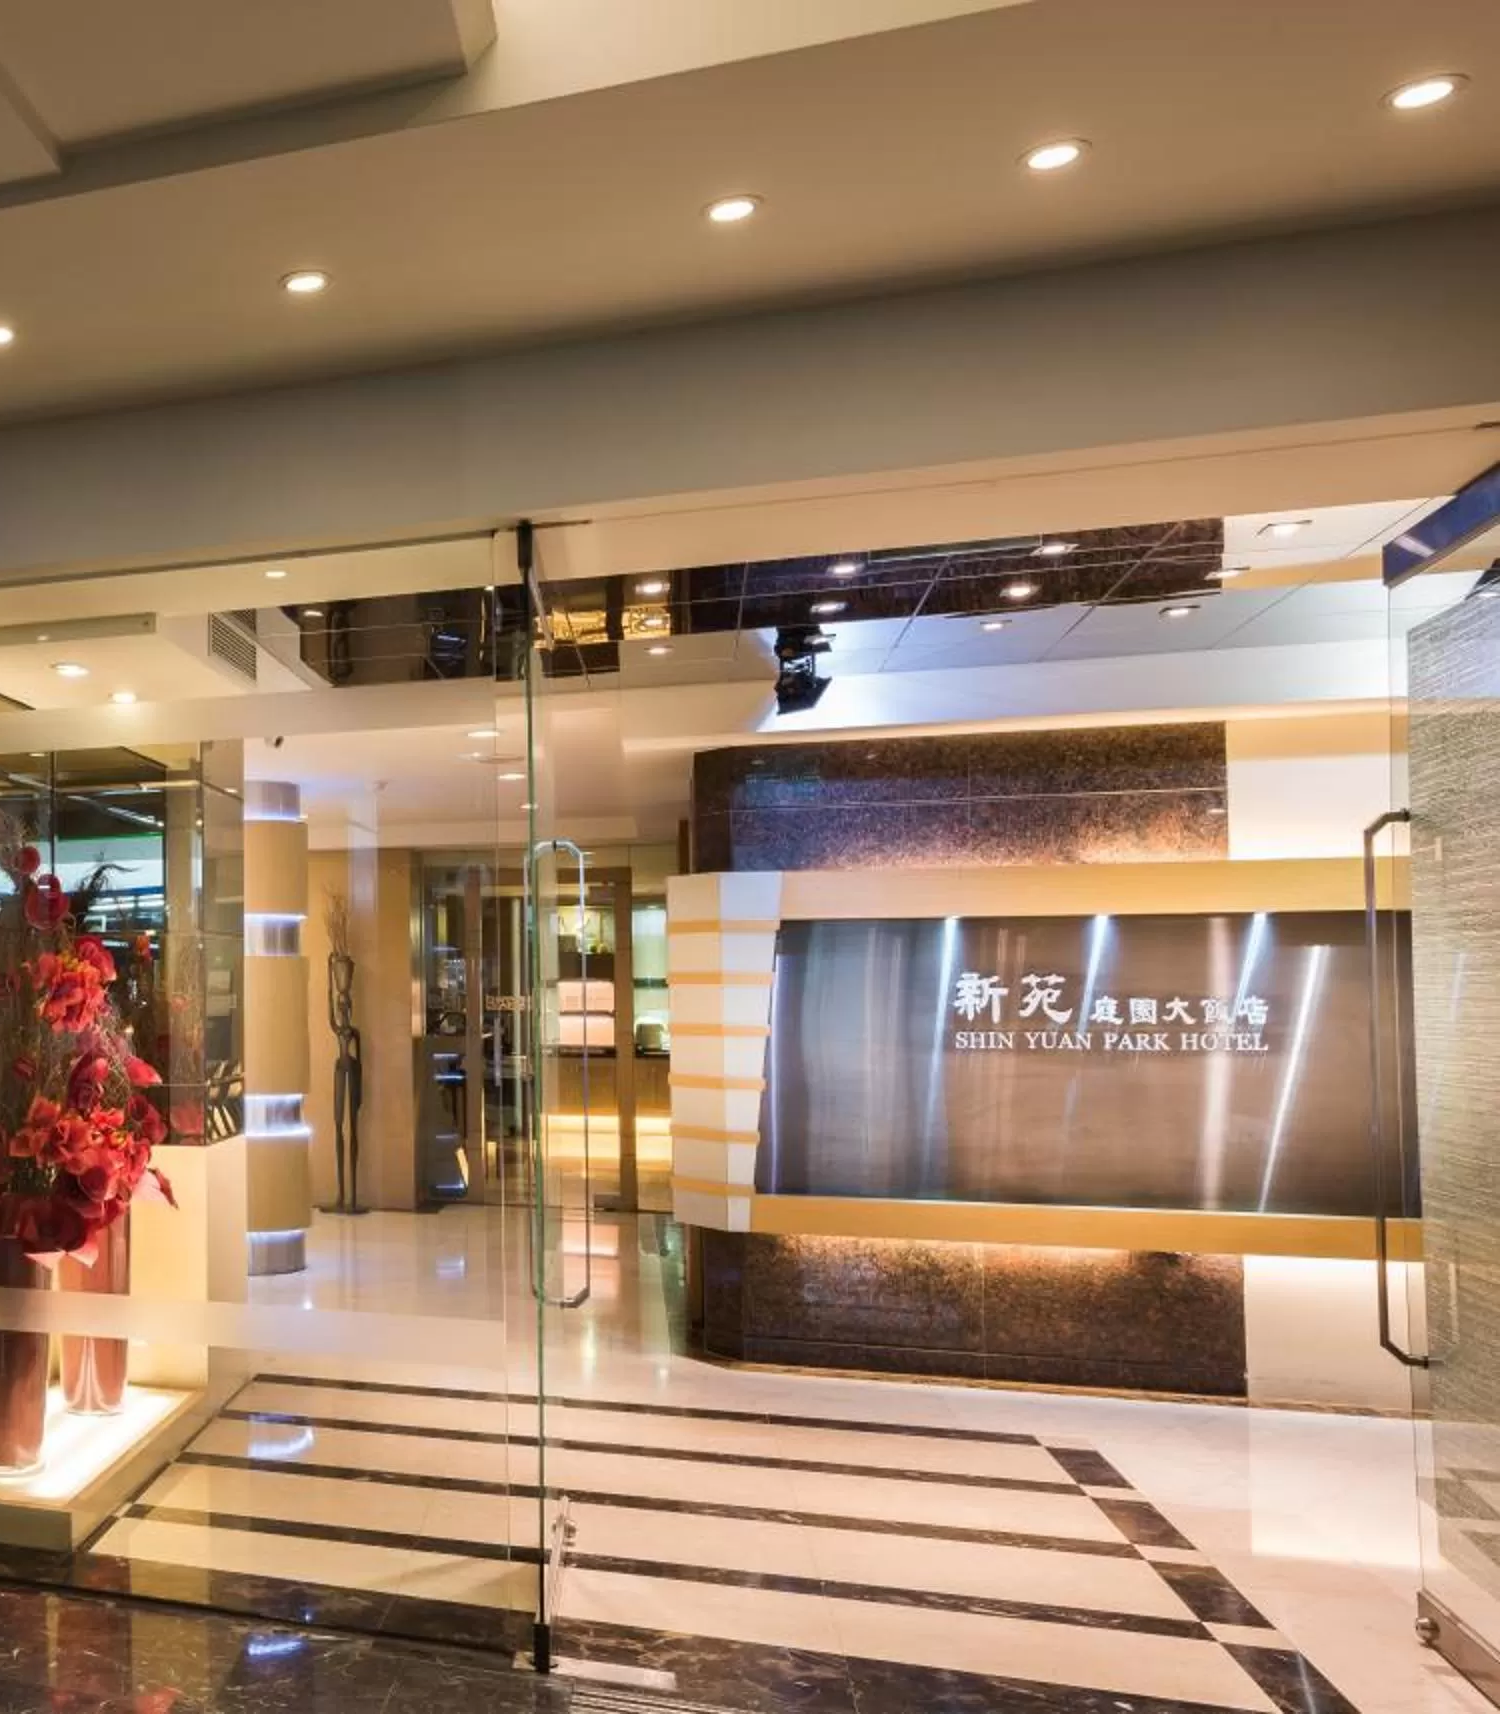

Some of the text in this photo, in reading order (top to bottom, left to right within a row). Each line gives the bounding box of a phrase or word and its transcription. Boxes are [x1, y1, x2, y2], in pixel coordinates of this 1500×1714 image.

[954, 1031, 1269, 1052] SHIN YUAN PARK HOTEL
